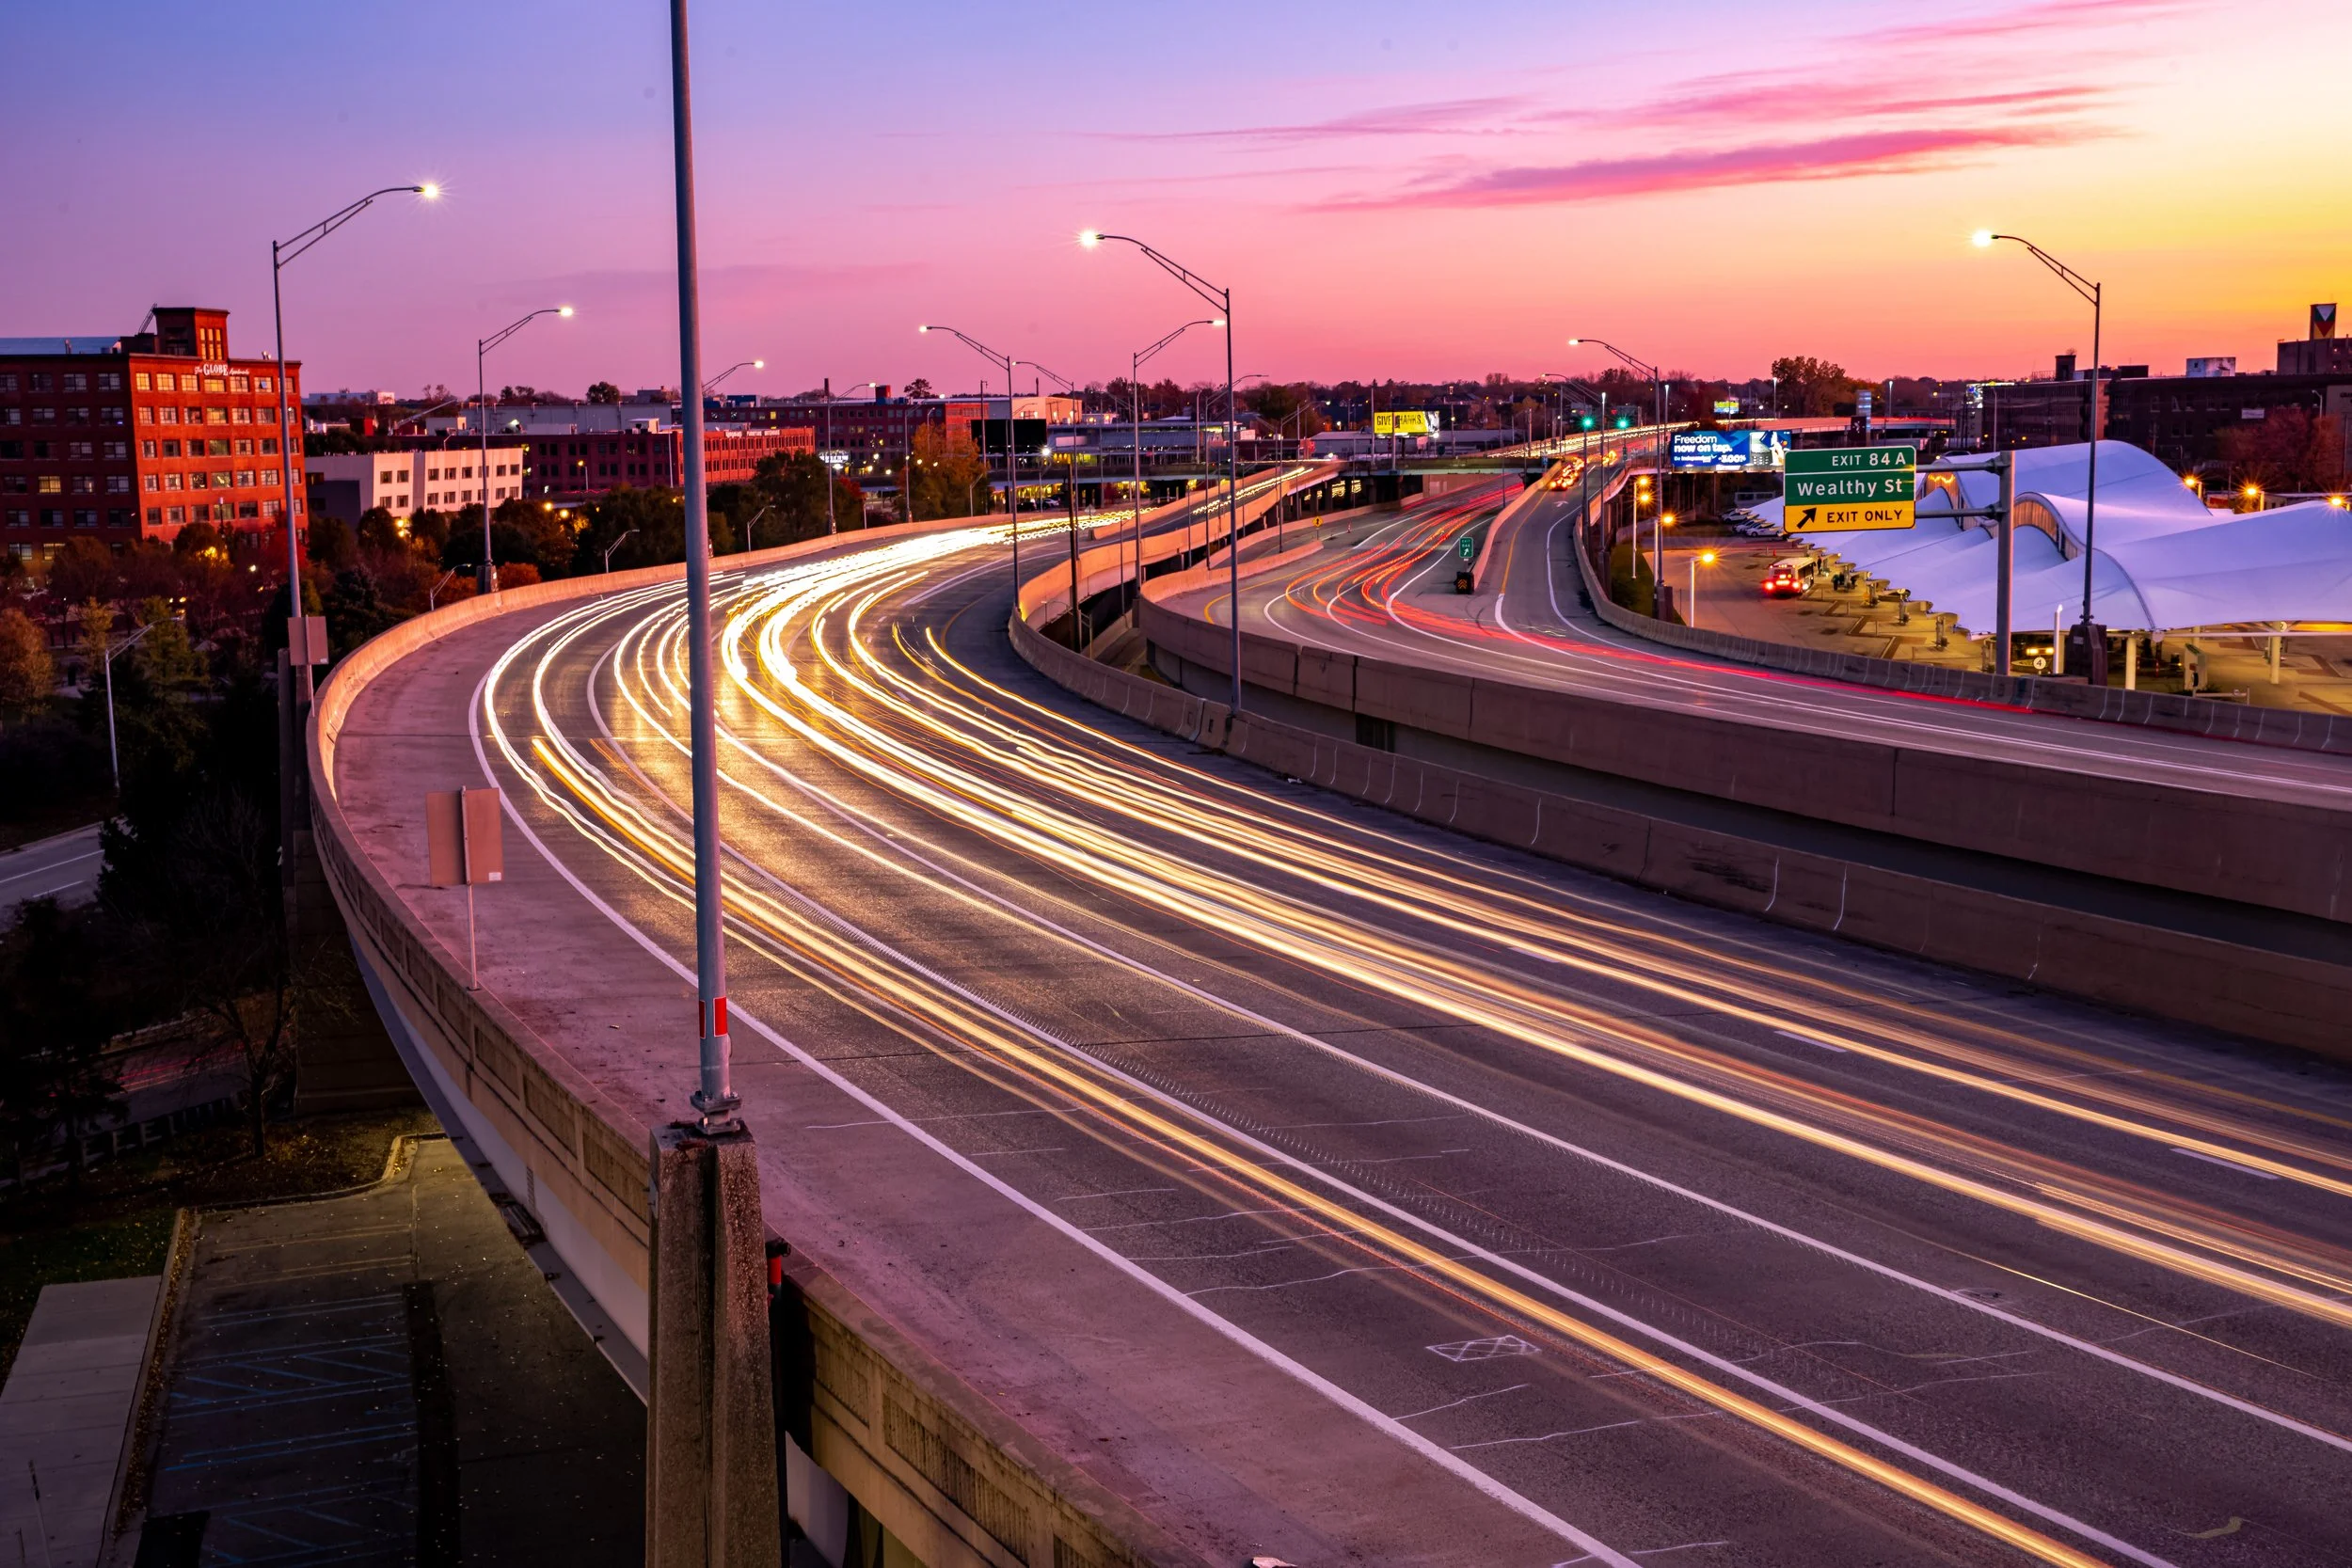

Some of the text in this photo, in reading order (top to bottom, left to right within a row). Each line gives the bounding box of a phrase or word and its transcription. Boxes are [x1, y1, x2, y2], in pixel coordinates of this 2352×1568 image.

[203, 363, 228, 375] GLOBE
[1376, 415, 1391, 425] GIVE
[1675, 435, 1717, 444] Freedom
[1674, 443, 1733, 453] now on tap.
[1832, 451, 1906, 467] EXIT 84 A
[1797, 478, 1902, 498] Wealthy St
[1827, 509, 1902, 523] EXIT ONLY
